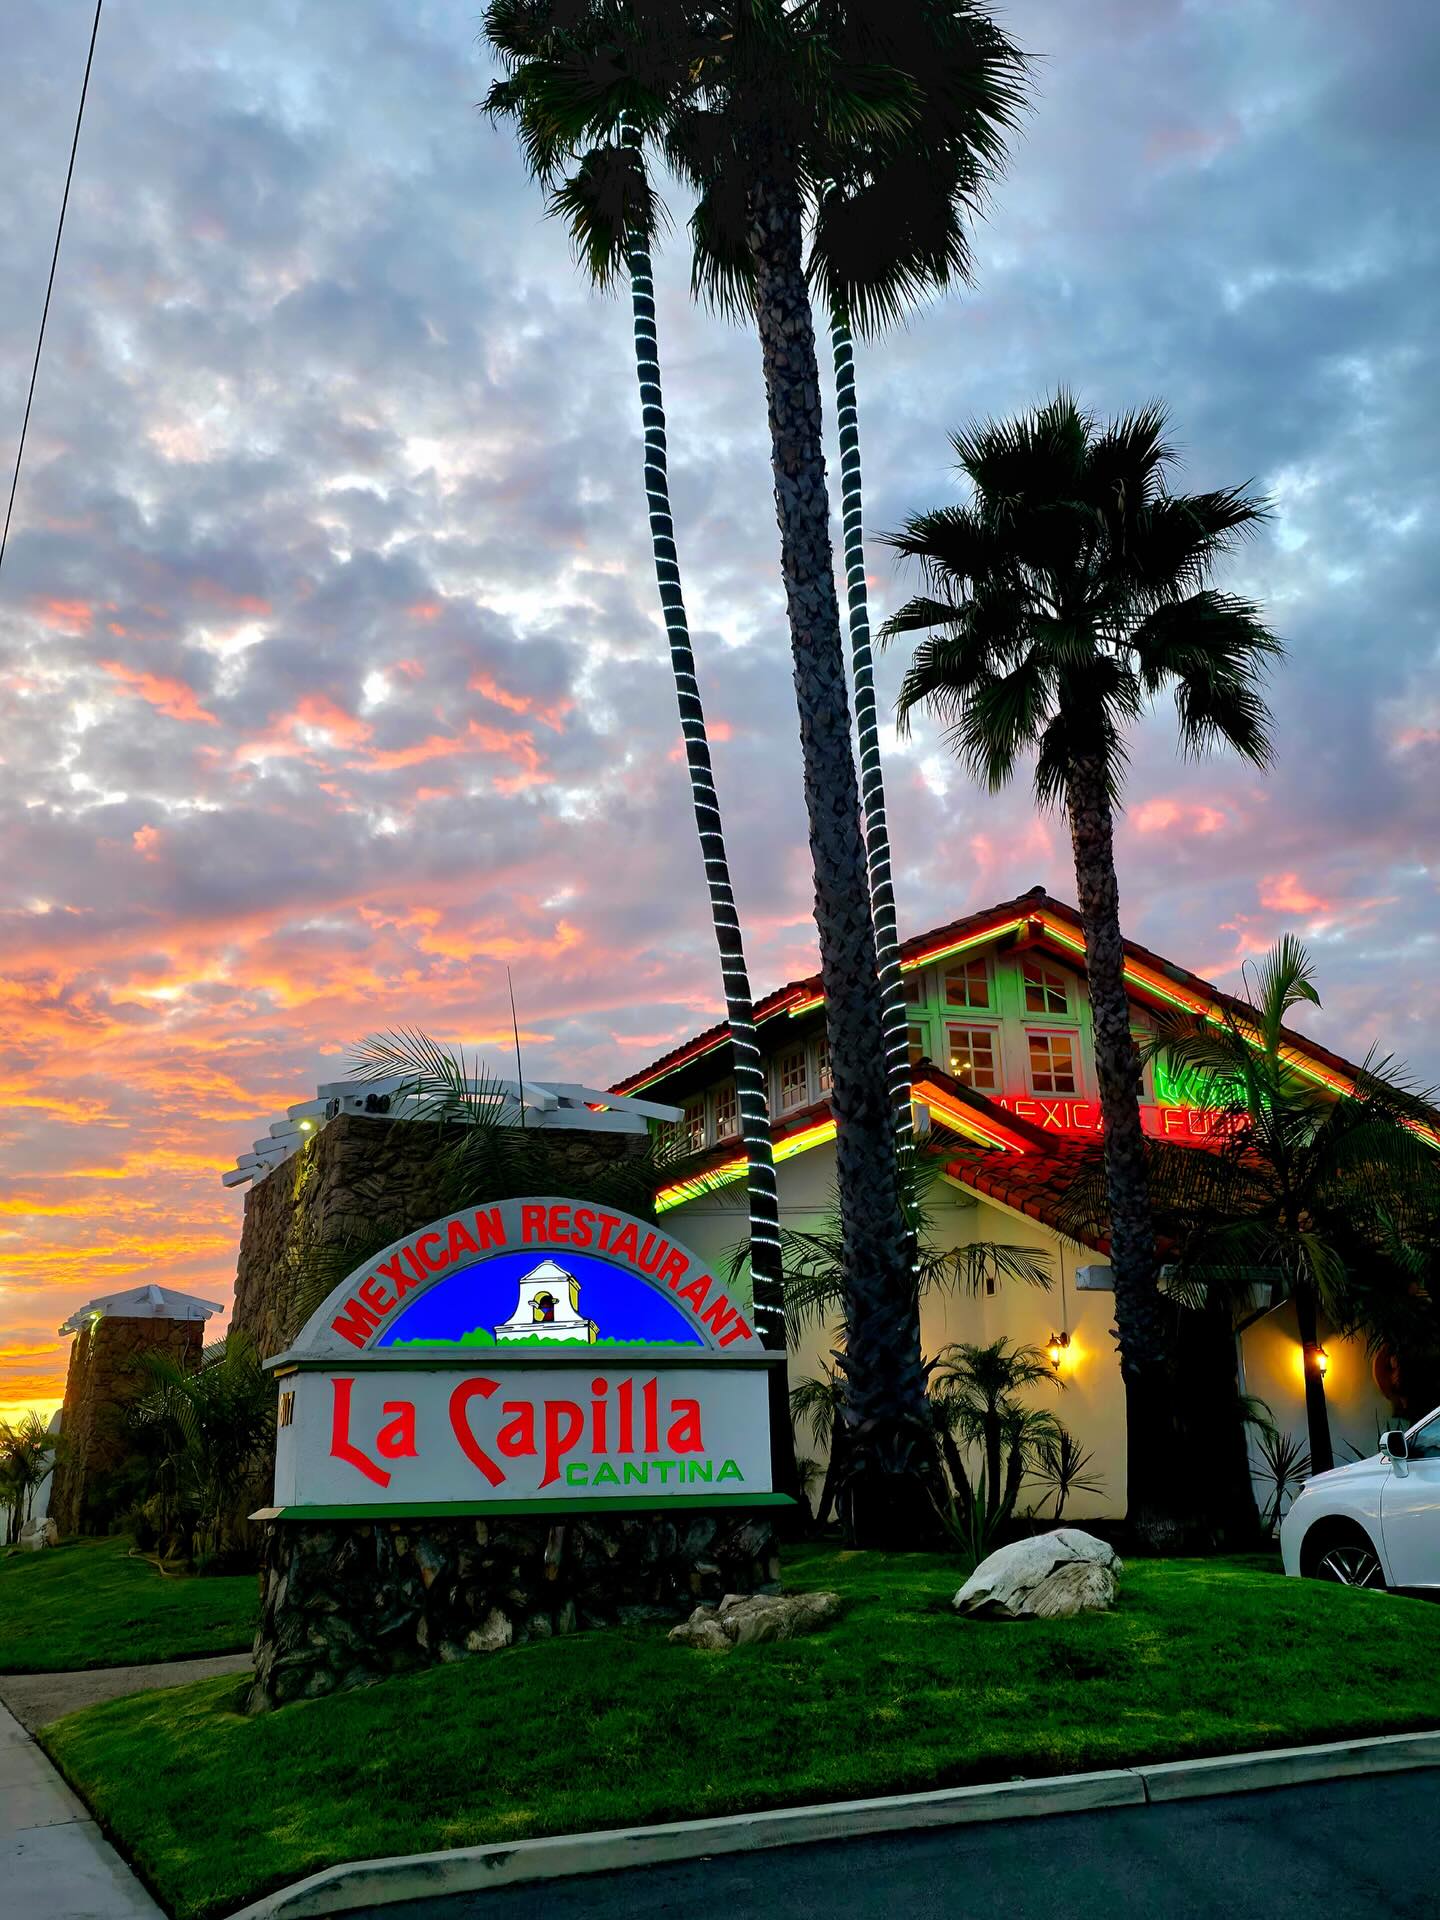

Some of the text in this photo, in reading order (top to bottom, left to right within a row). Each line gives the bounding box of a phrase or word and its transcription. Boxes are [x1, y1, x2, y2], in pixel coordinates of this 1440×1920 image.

[1000, 1099, 1103, 1129] EXIC
[331, 1203, 754, 1350] MEXICAN RESTAURANT
[329, 1376, 706, 1490] La Capilla
[565, 1458, 745, 1488] CANTINA
